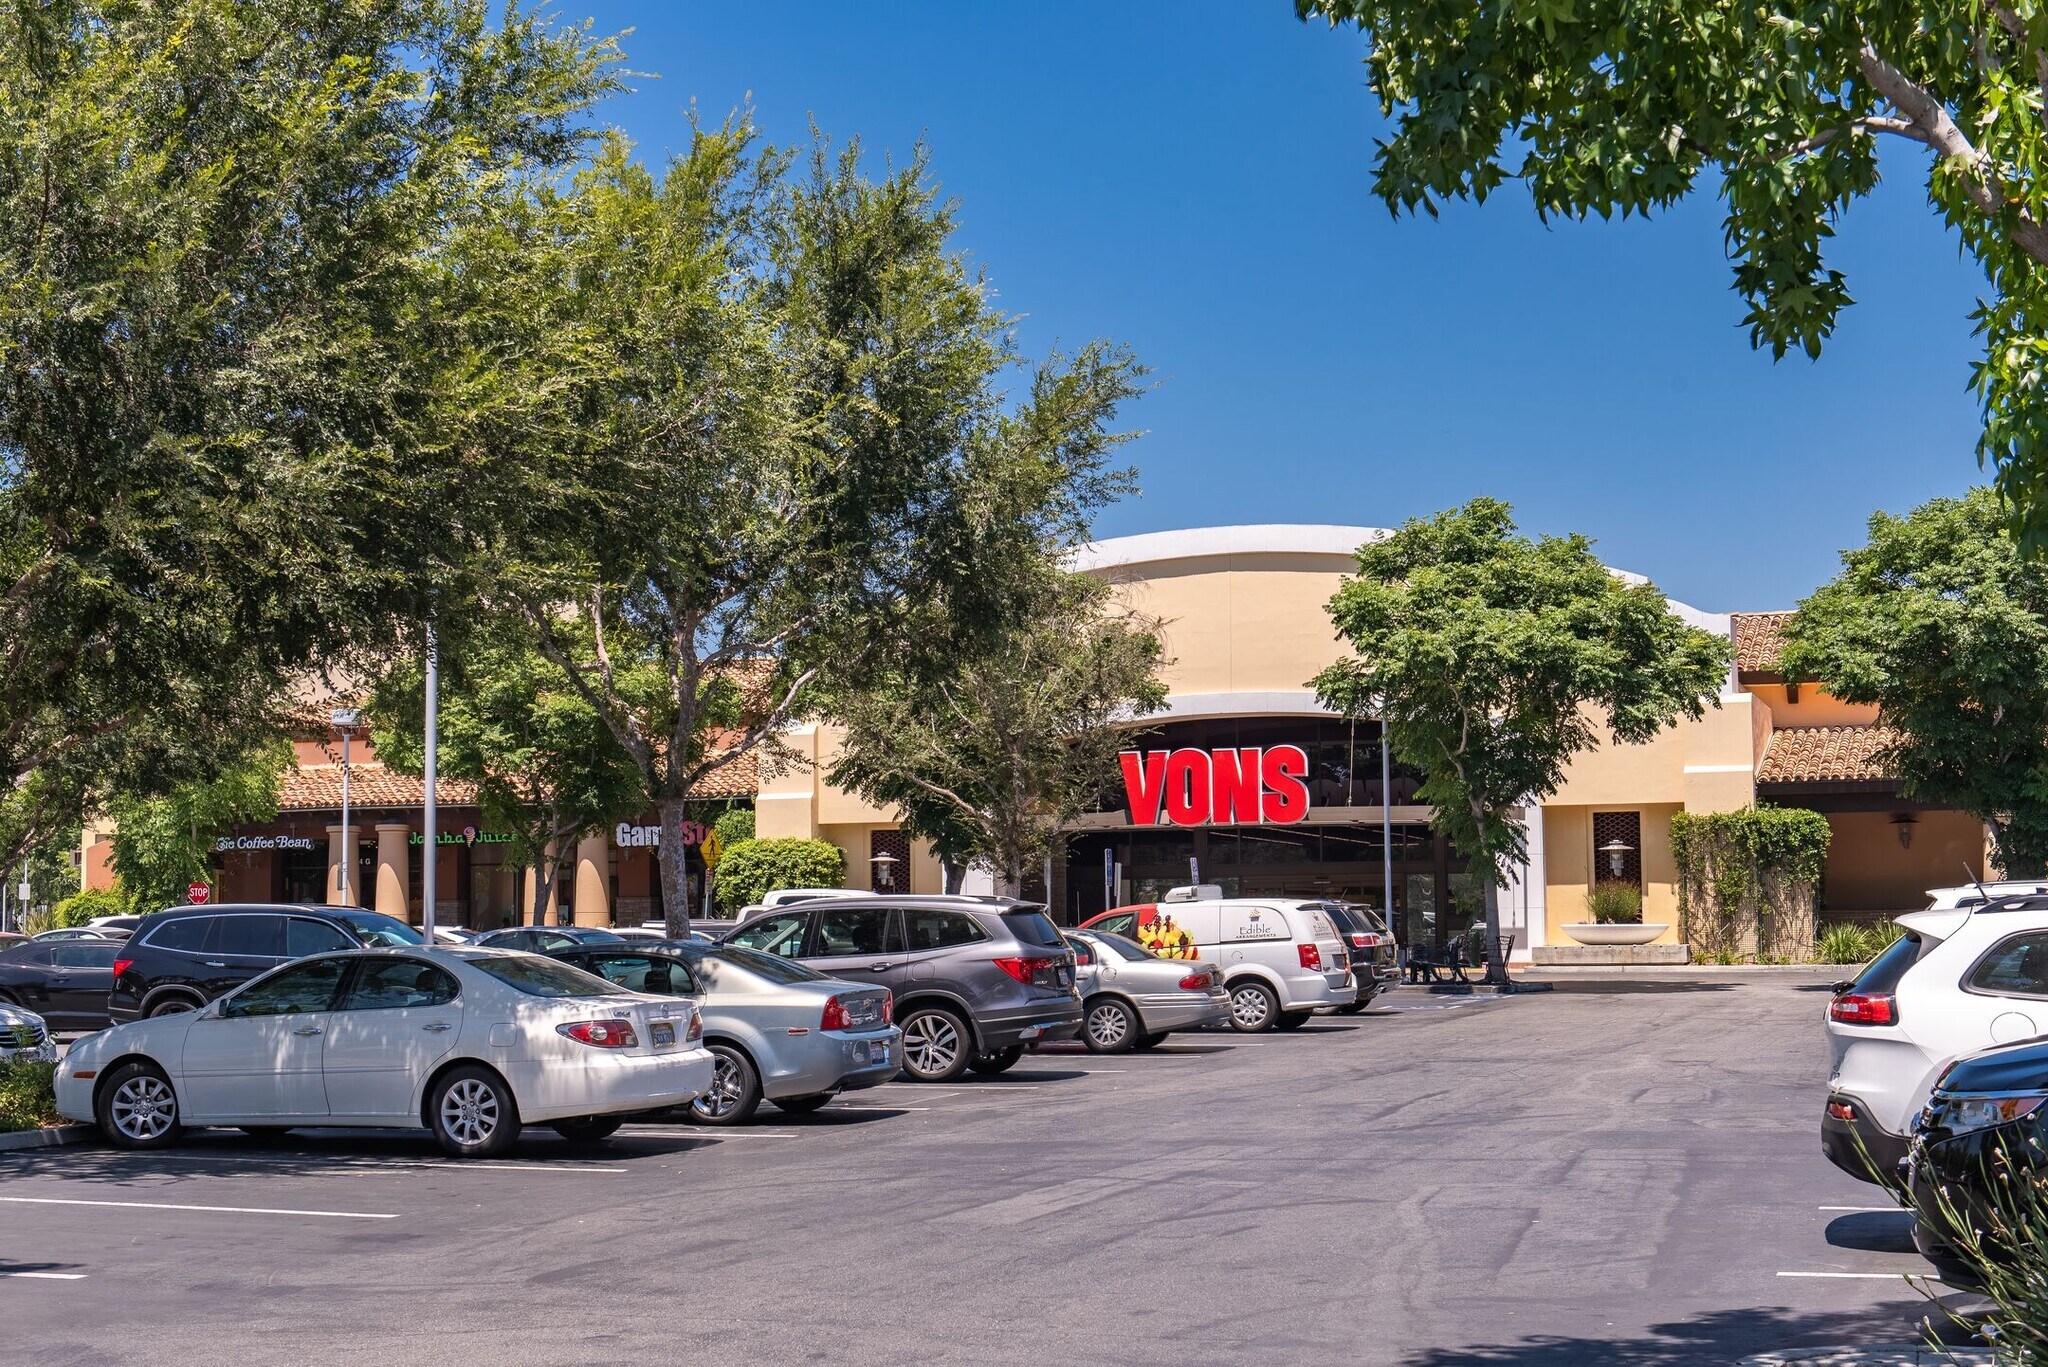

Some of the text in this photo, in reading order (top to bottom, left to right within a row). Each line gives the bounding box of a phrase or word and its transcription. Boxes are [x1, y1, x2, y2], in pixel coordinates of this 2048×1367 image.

[1119, 745, 1310, 827] VONS
[236, 836, 275, 849] Coffee
[275, 835, 312, 850] Bean
[190, 887, 208, 897] STOP
[1239, 923, 1271, 935] Edible
